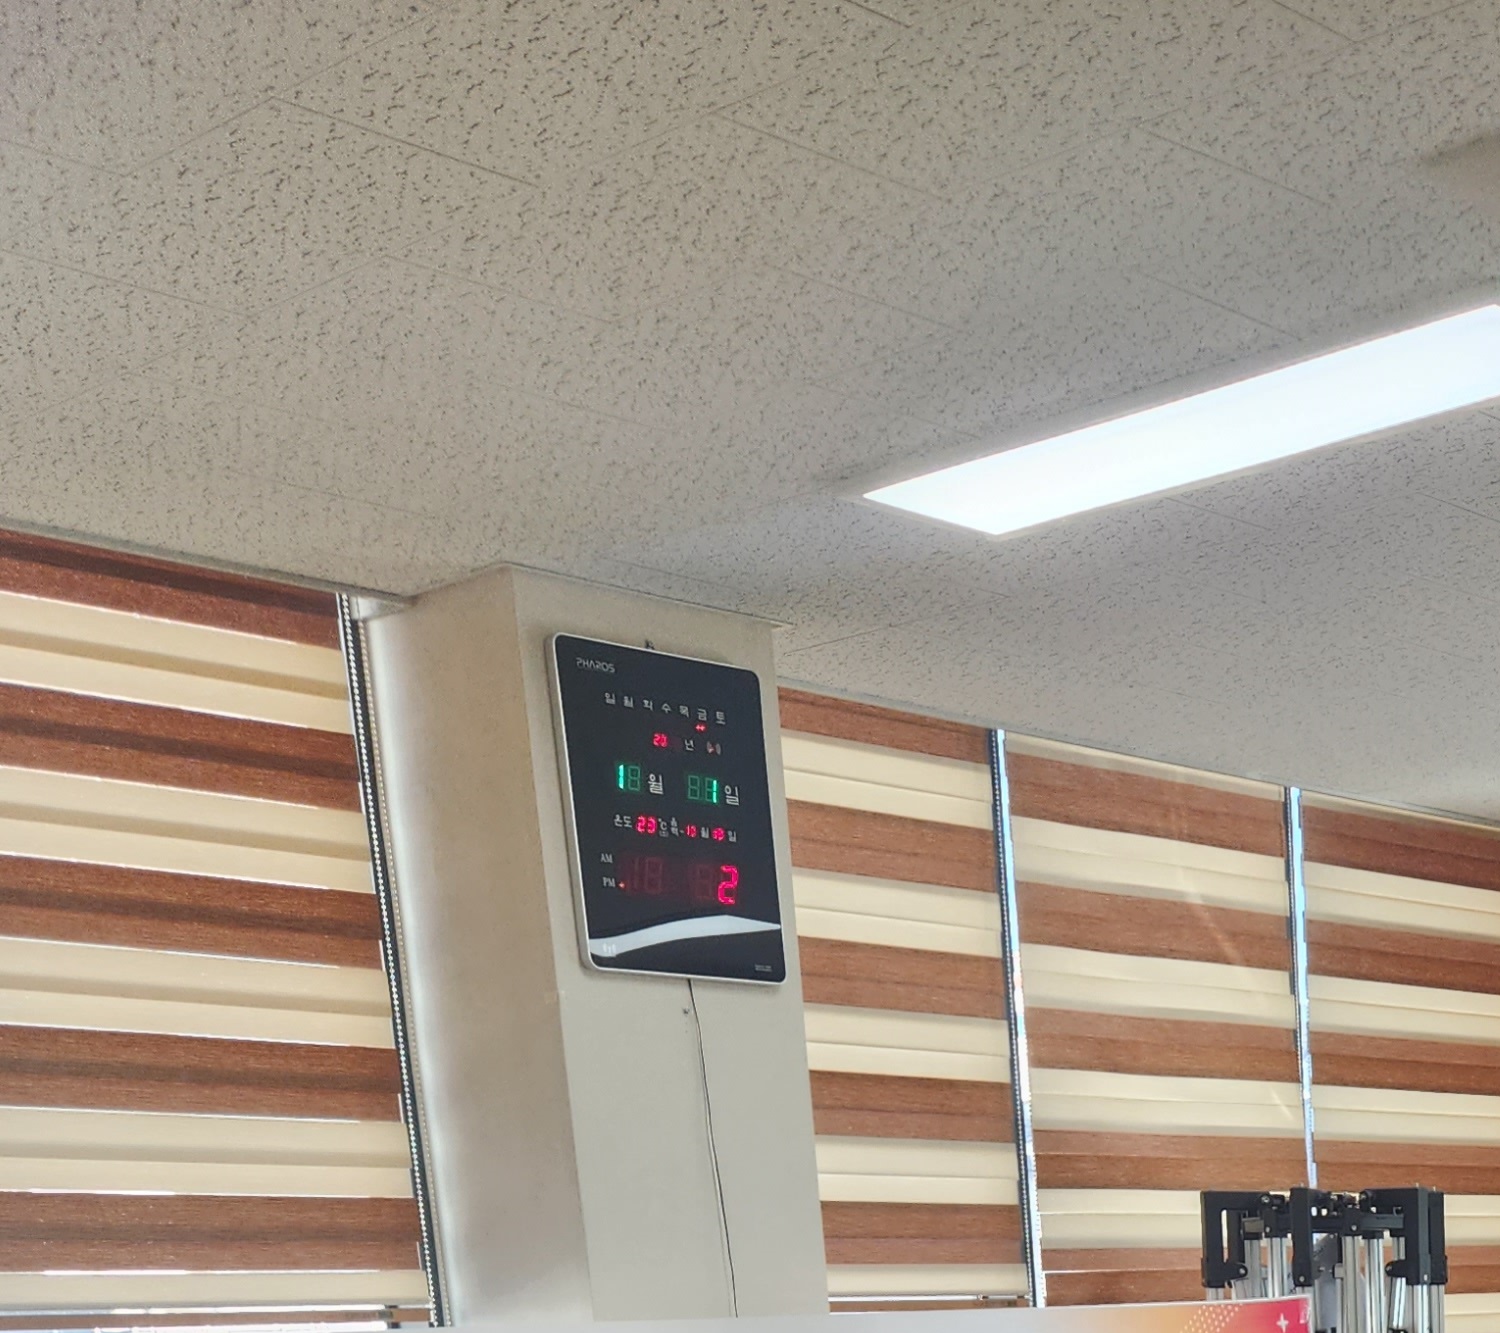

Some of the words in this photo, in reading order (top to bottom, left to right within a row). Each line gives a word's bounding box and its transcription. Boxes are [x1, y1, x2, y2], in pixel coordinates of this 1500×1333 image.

[661, 703, 672, 714] 수
[697, 708, 708, 721] 금
[716, 711, 726, 725] 토
[684, 739, 694, 751] 년
[648, 773, 664, 795] 월
[724, 785, 740, 806] 일
[614, 814, 632, 829] 온도
[600, 852, 613, 864] AM
[602, 876, 616, 888] PM
